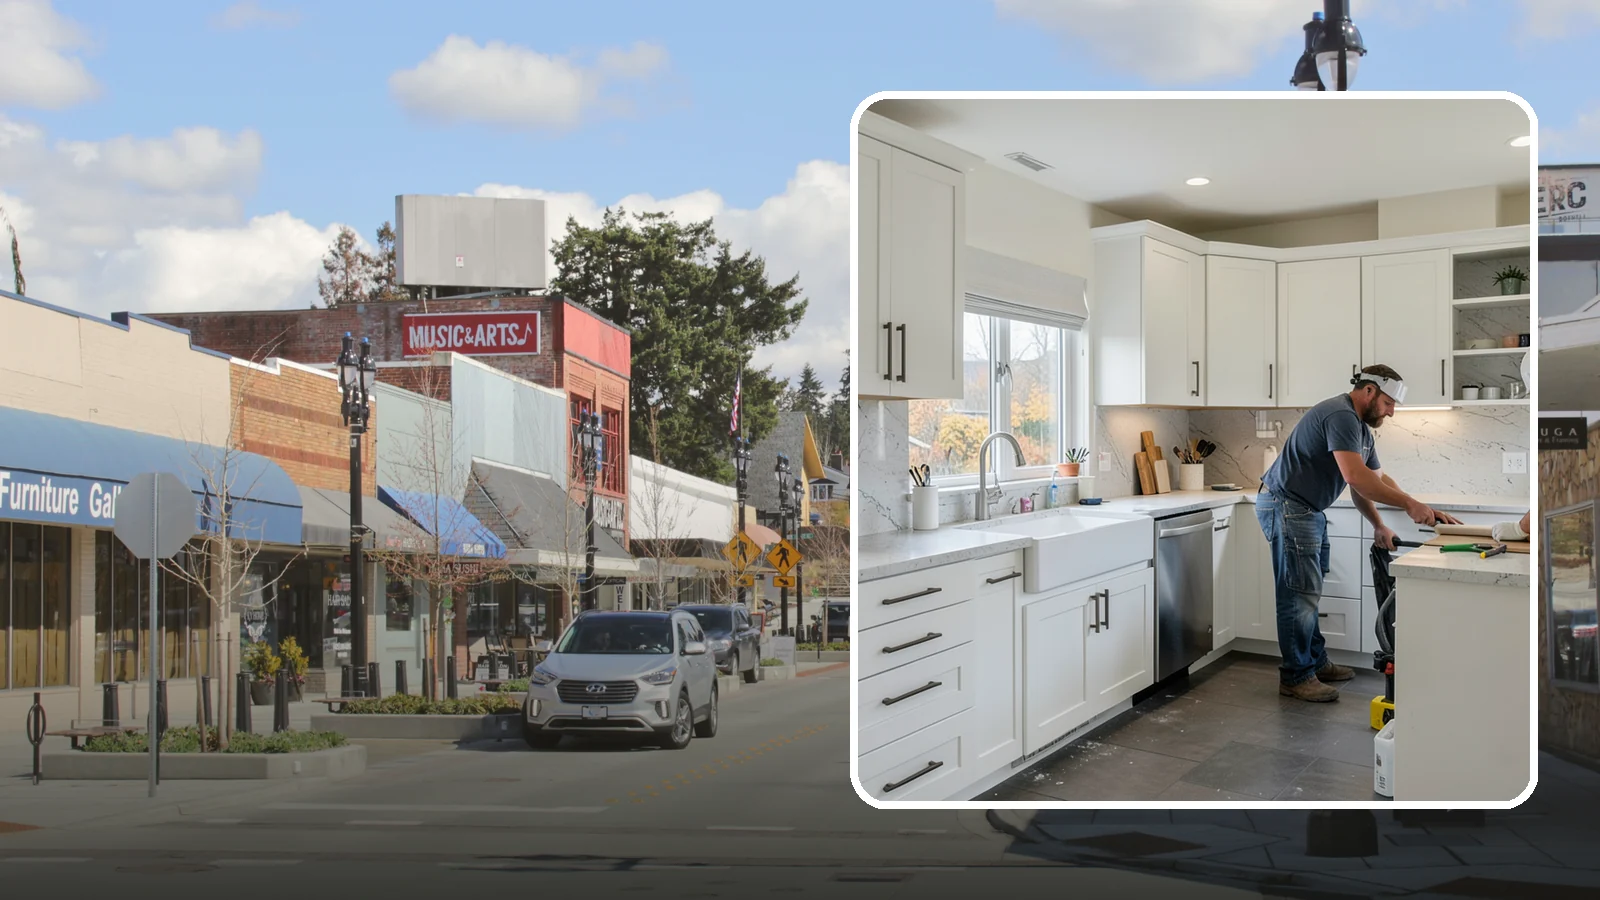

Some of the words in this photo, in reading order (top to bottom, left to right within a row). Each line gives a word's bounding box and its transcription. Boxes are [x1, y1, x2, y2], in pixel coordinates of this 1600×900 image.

[409, 323, 519, 349] MUSIC&ARTS
[0, 471, 79, 515] Furniture
[453, 563, 479, 574] SUSHI
